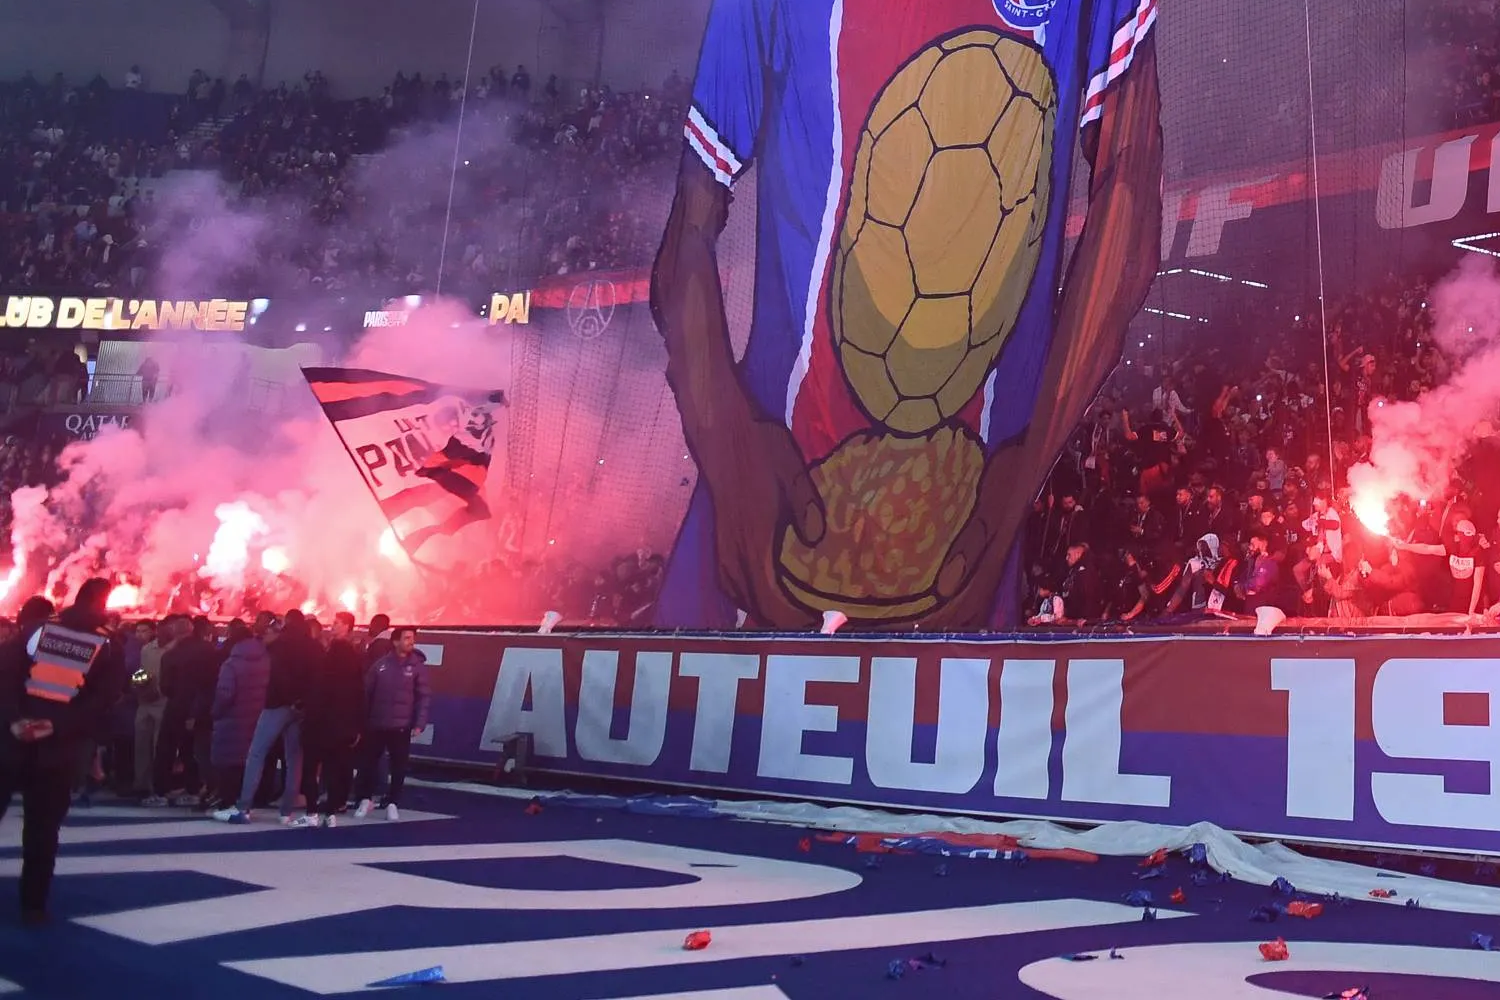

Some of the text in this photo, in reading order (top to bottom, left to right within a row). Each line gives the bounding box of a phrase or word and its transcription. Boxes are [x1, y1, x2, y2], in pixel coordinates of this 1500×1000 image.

[56, 296, 105, 330] DE
[107, 298, 248, 331] L'ANNÉE
[489, 292, 530, 325] PA
[478, 646, 1172, 808] AUTEUIL
